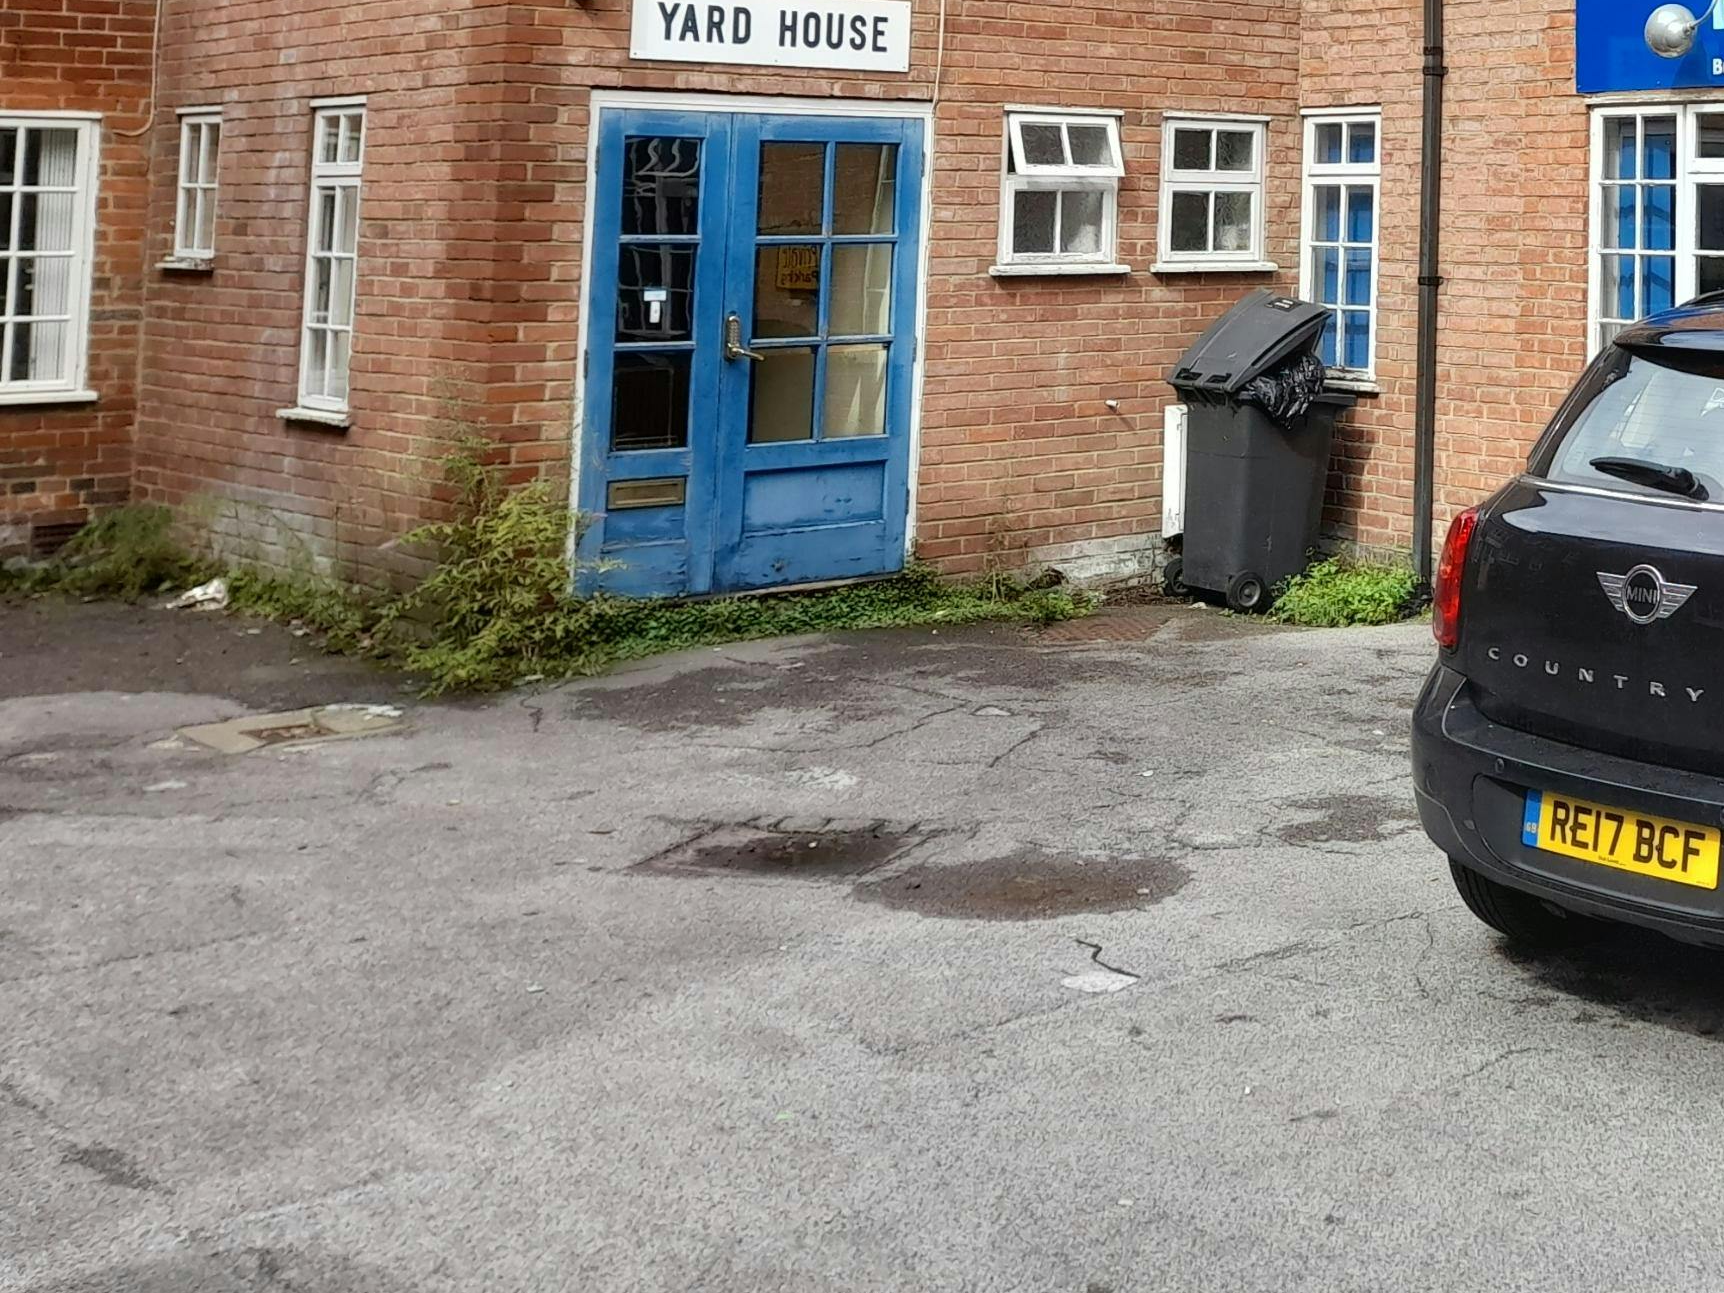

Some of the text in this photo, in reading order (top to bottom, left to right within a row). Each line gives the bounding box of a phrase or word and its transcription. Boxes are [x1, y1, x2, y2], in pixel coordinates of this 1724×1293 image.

[657, 1, 889, 53] YARD HOUSE
[1627, 585, 1659, 605] MINI
[1550, 799, 1707, 873] RE17 BCF
